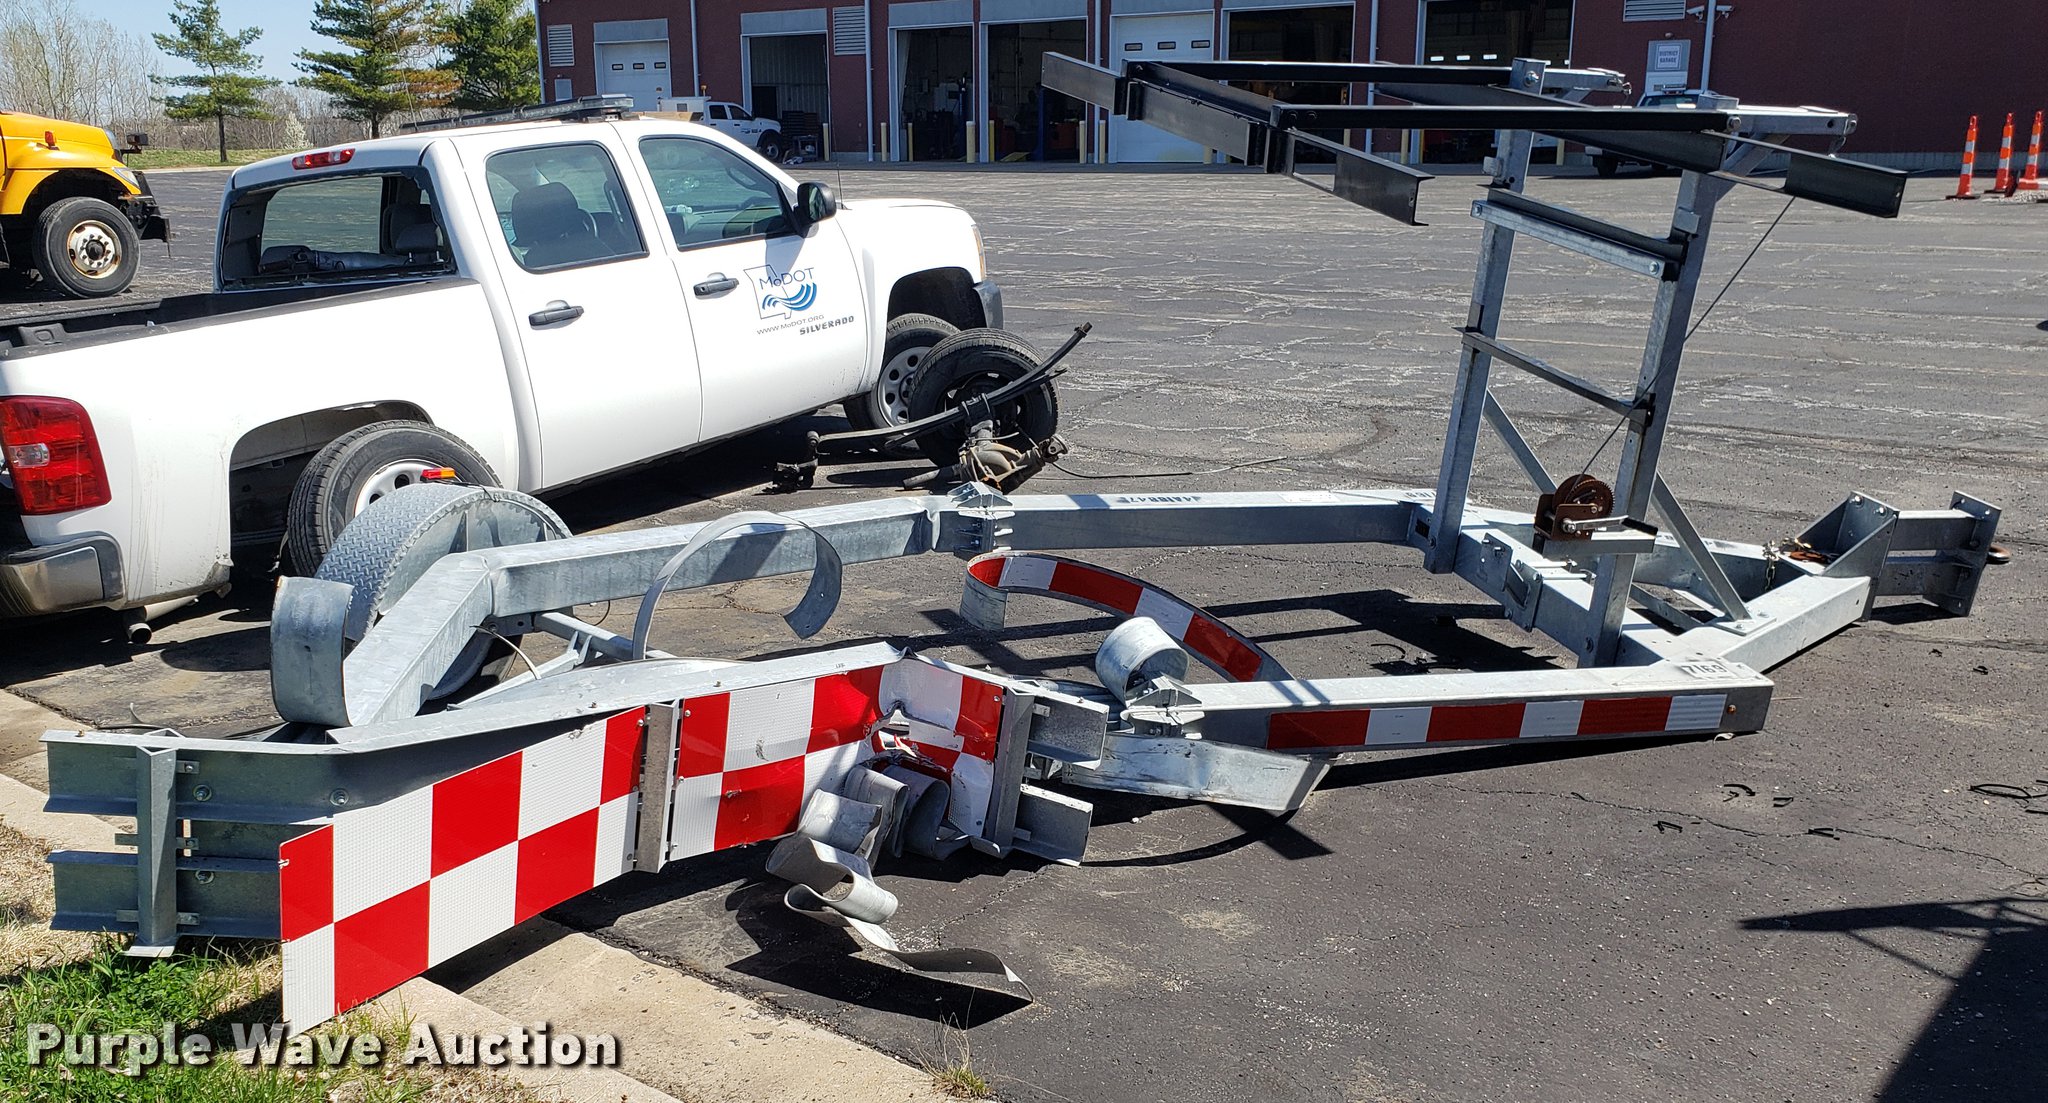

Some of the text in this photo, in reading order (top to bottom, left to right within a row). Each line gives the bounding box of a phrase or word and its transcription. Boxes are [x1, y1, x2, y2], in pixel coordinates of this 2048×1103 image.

[759, 267, 814, 289] MoDOT
[757, 314, 824, 335] WWW.MoDOT.ORG
[799, 315, 855, 335] SILVERADO
[1681, 664, 1728, 673] 7169
